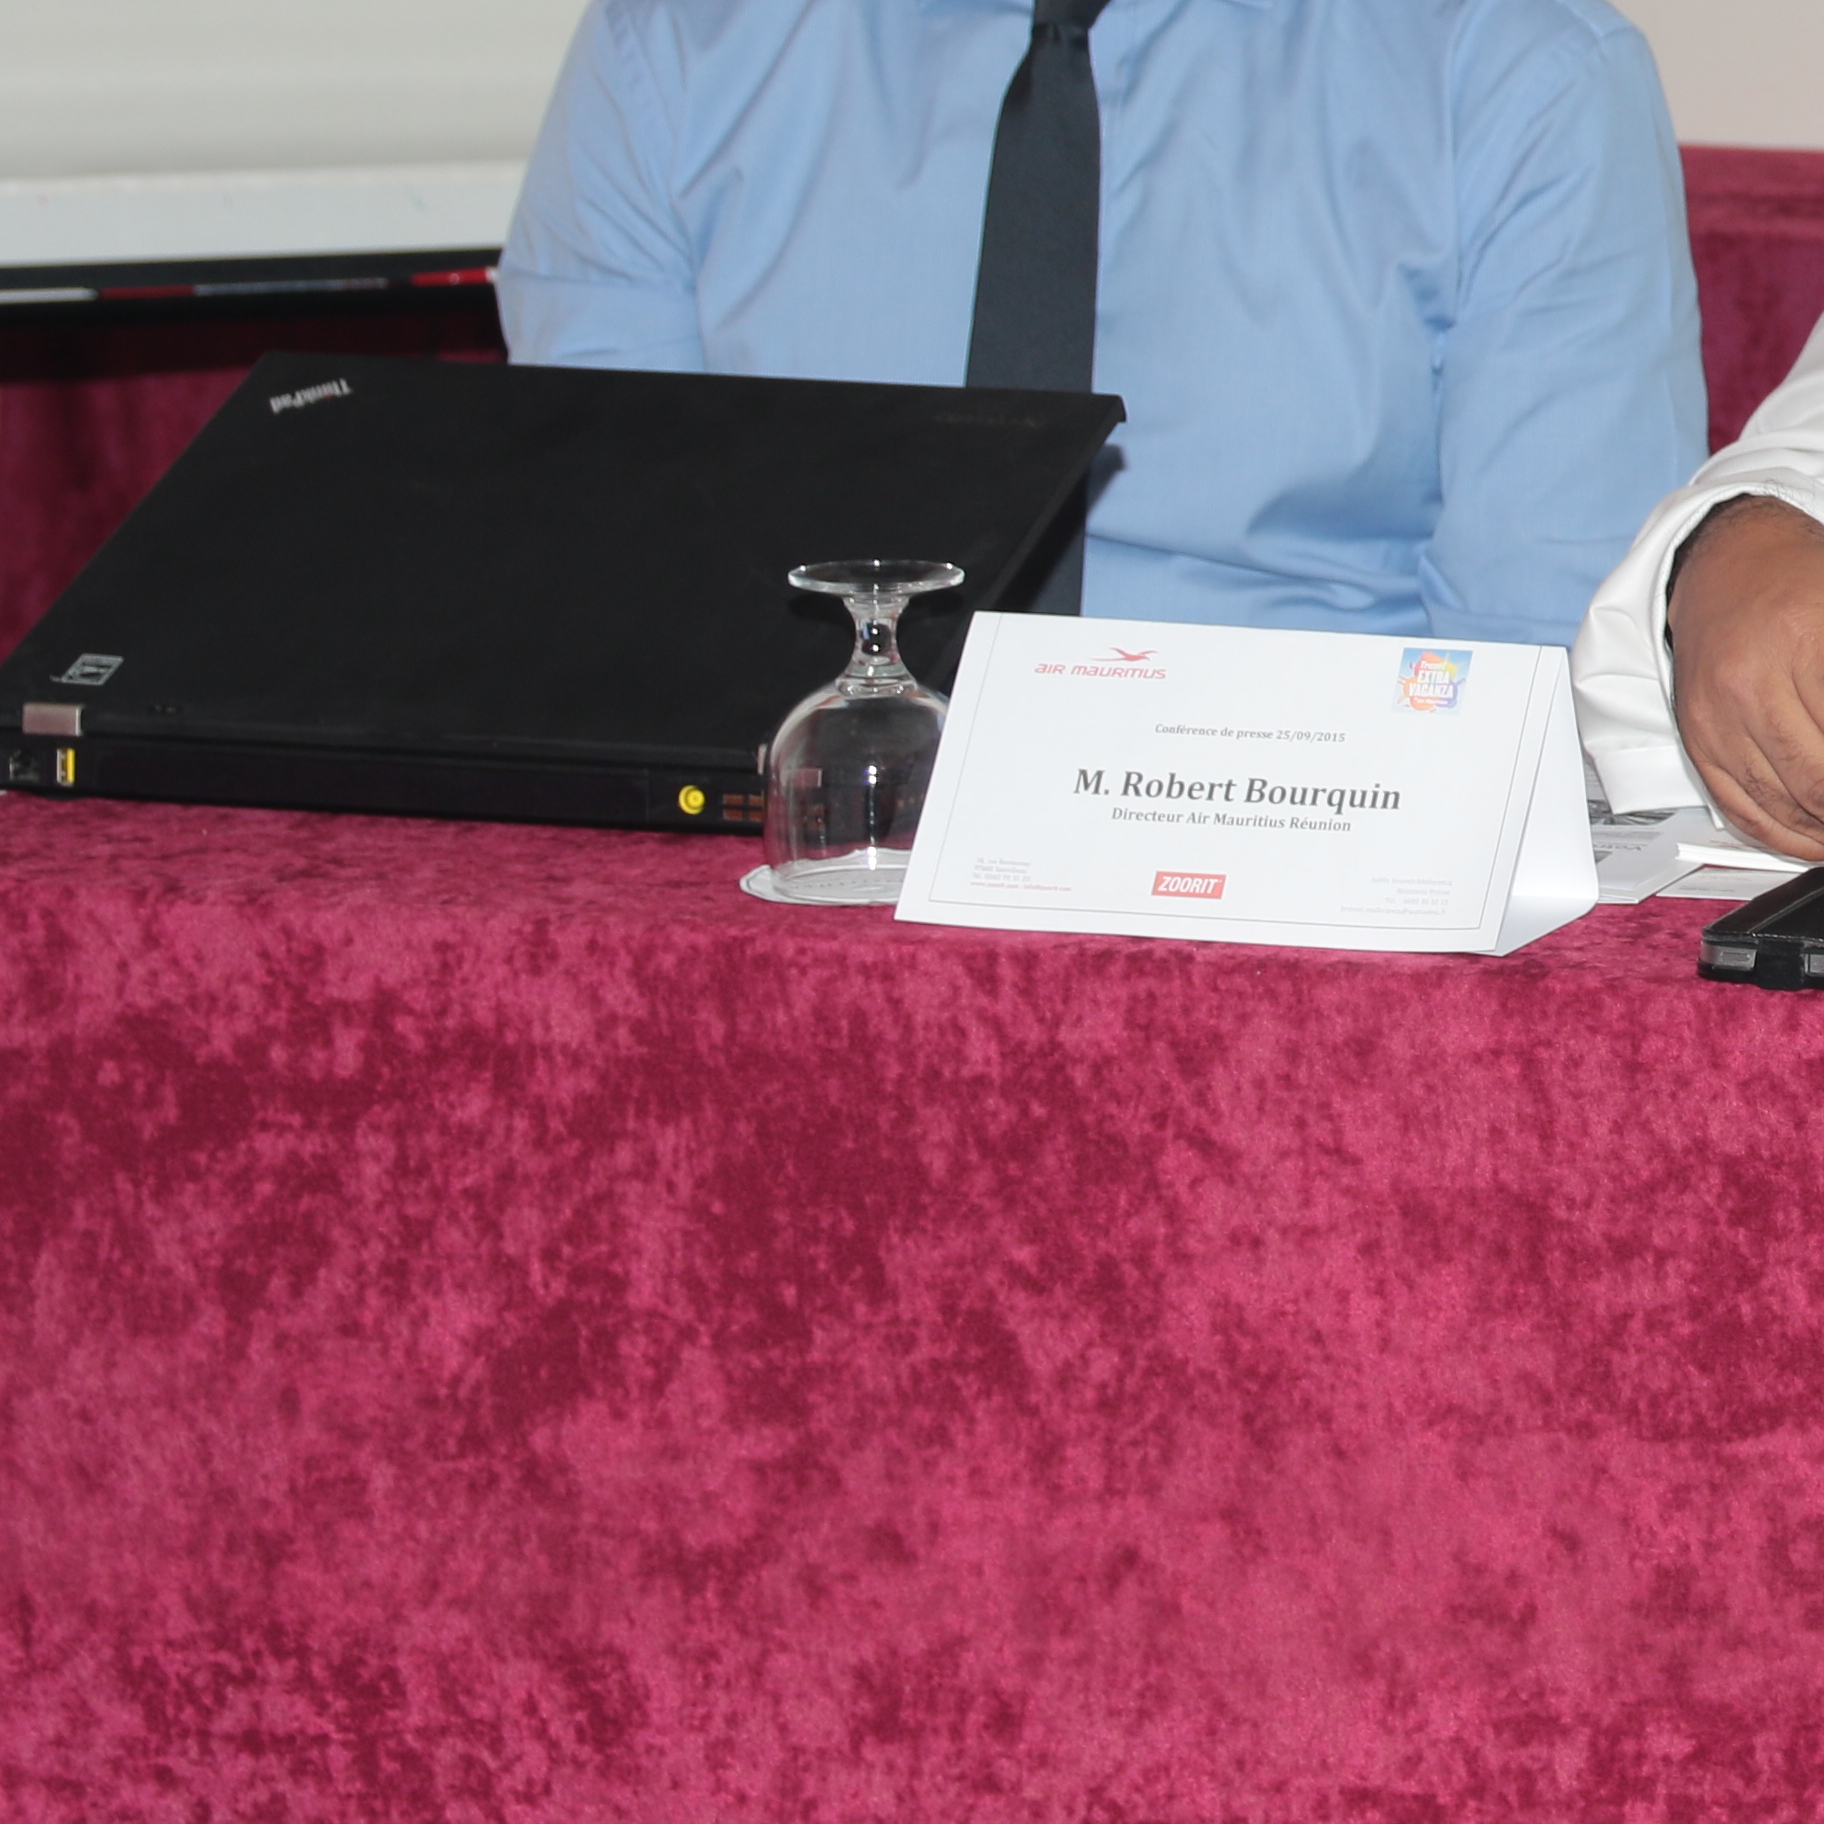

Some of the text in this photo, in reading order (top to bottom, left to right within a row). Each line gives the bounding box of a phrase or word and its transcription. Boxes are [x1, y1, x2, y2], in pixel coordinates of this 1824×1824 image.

[1155, 723, 1346, 743] Conférence de presse 25/09/2015
[1073, 769, 1401, 816] M. Robert Bourquin
[1111, 807, 1351, 832] Directeur Air Mauritius Réunion
[1158, 875, 1219, 894] ZOORIT
